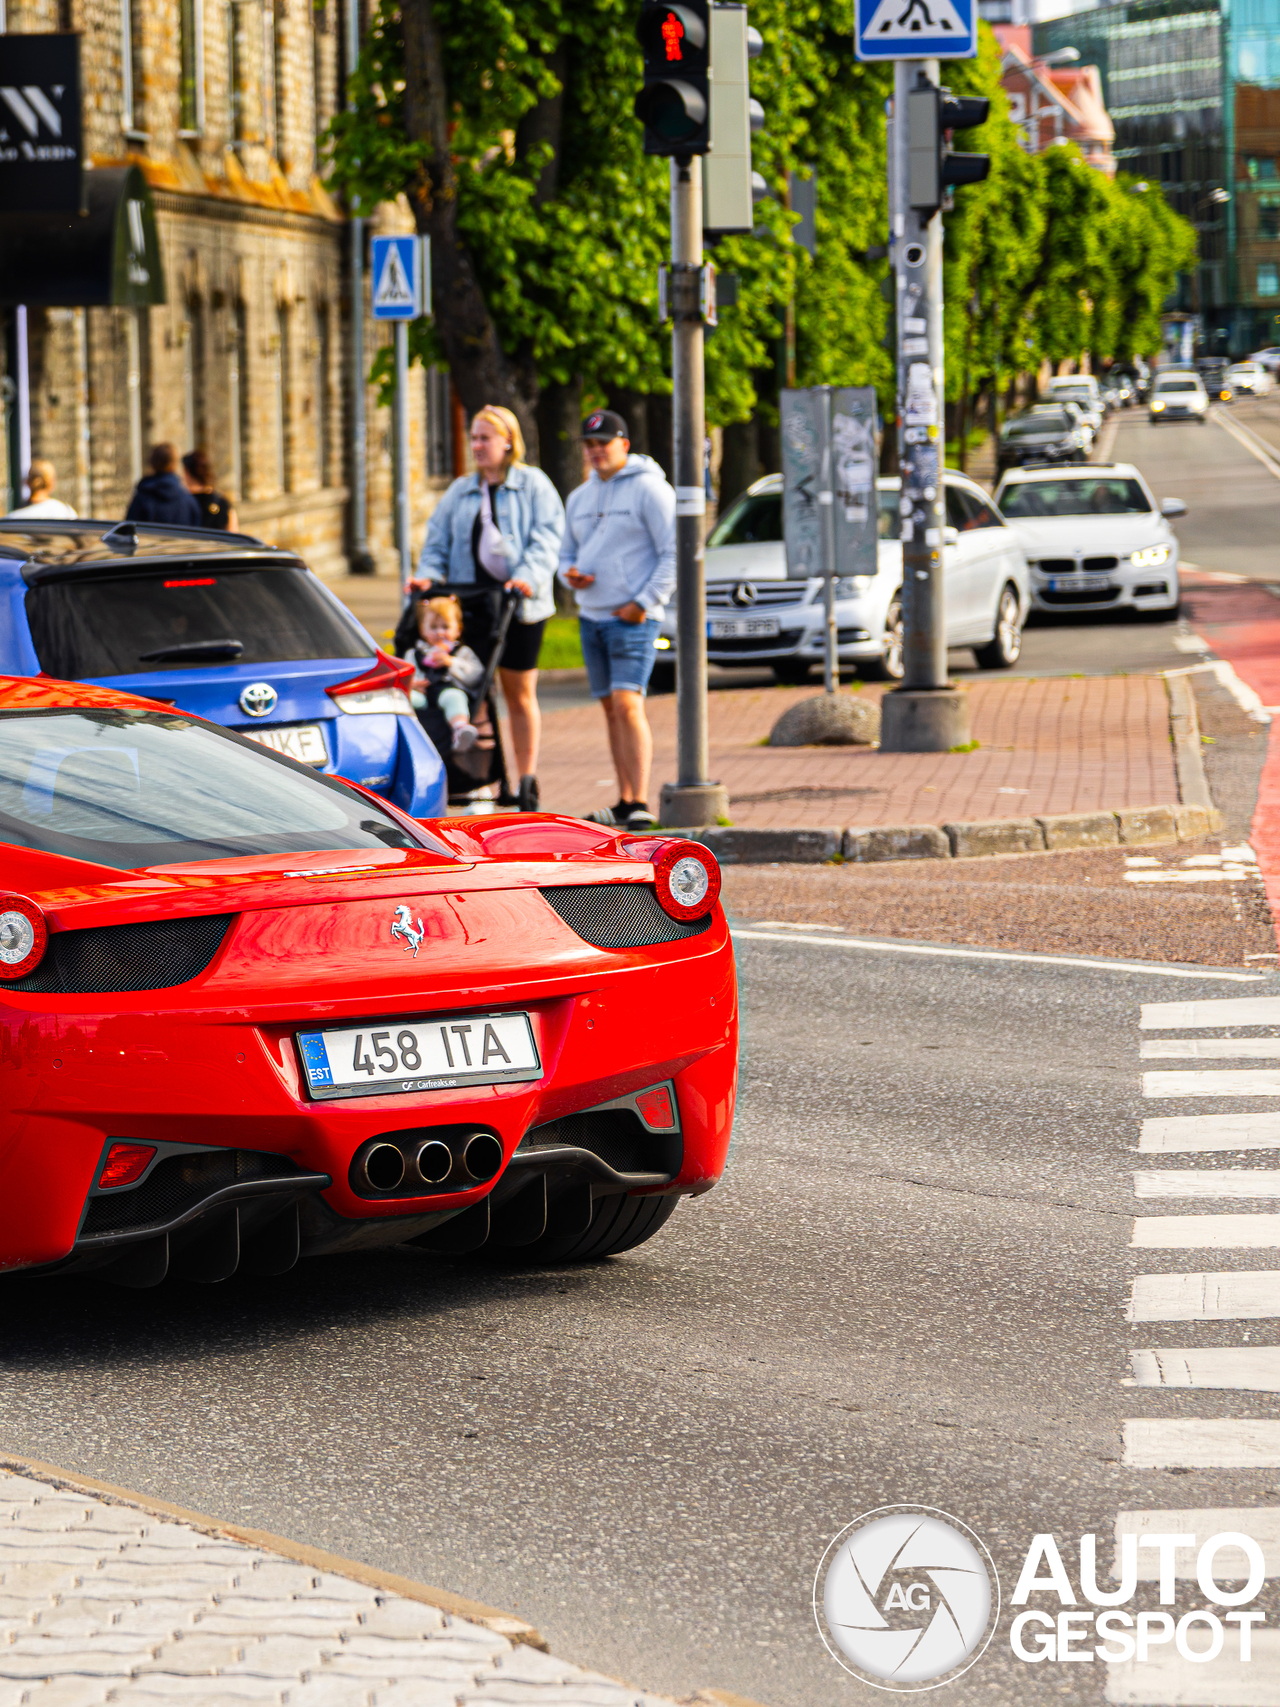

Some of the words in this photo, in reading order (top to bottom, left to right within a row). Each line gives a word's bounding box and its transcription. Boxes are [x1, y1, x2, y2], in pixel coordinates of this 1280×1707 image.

[353, 1030, 422, 1075] 458
[440, 1023, 512, 1068] ITA
[309, 1067, 331, 1080] EST
[417, 1079, 457, 1089] Carfreaks.ee
